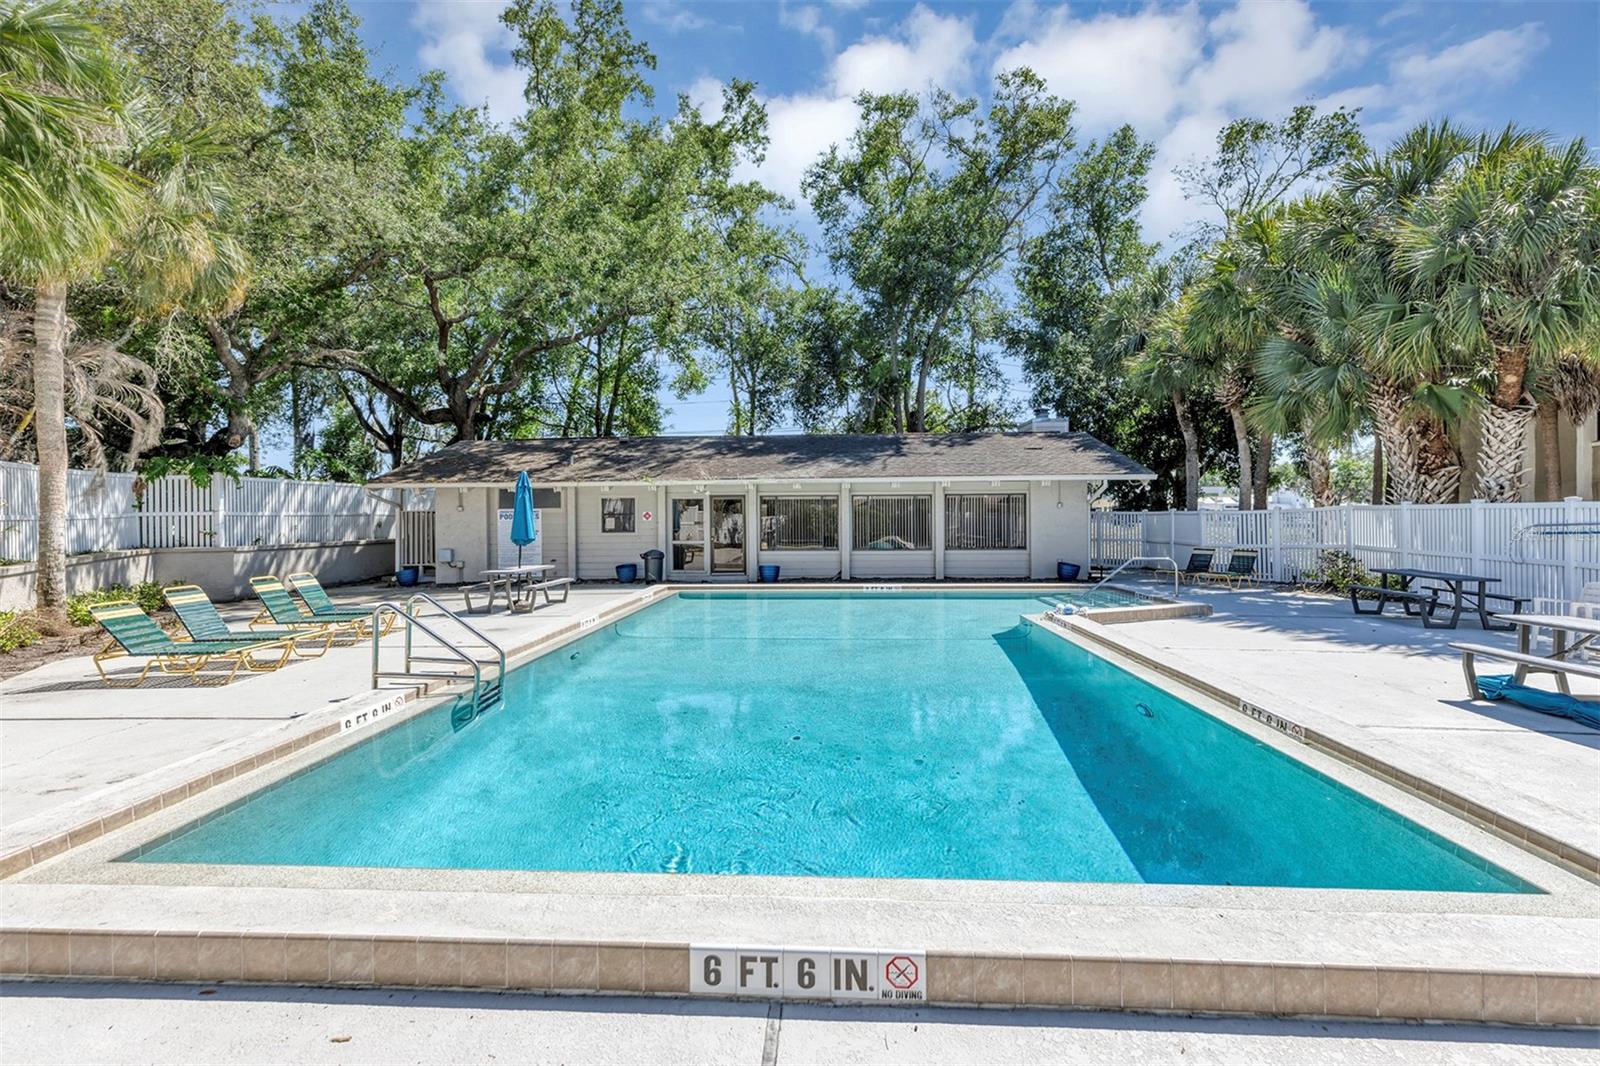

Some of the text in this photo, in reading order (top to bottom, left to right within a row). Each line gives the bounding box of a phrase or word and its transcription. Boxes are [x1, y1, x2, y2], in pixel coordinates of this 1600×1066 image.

[704, 954, 875, 992] 6 FT. 6 IN.
[881, 990, 923, 1000] NO DIVING
